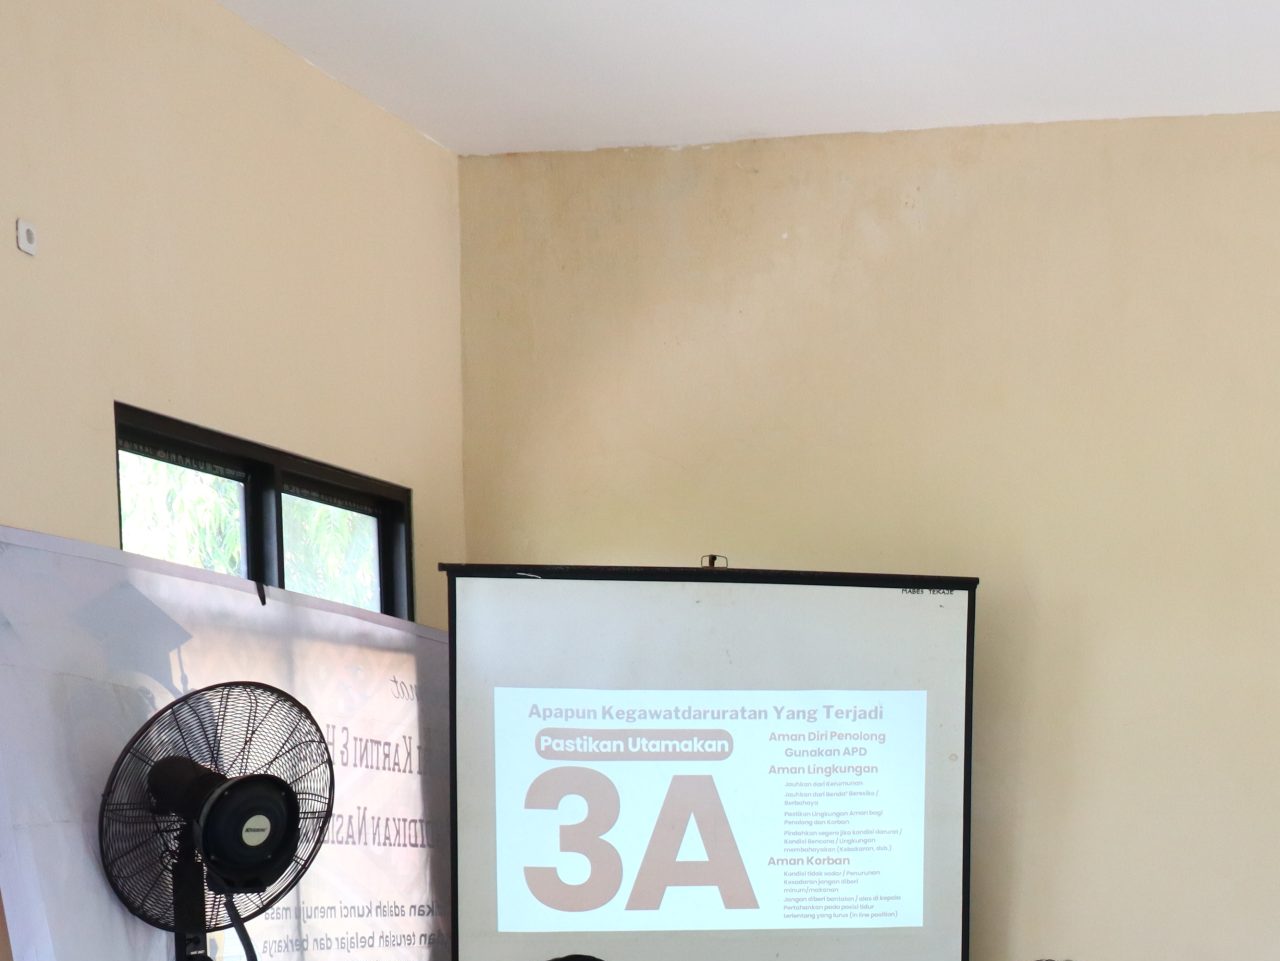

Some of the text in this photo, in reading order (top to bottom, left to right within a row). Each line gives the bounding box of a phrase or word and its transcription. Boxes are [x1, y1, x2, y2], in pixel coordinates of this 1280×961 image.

[528, 704, 884, 724] Apapun Kegawatdaruratan Yang Terjadi
[540, 735, 729, 753] Pastikan Utamakan
[769, 731, 886, 744] Aman Diri Penolong
[785, 747, 868, 757] Gunakan APD
[768, 764, 879, 777] Aman Lingkungan
[523, 765, 760, 912] 3A
[767, 856, 850, 866] Aman Korban
